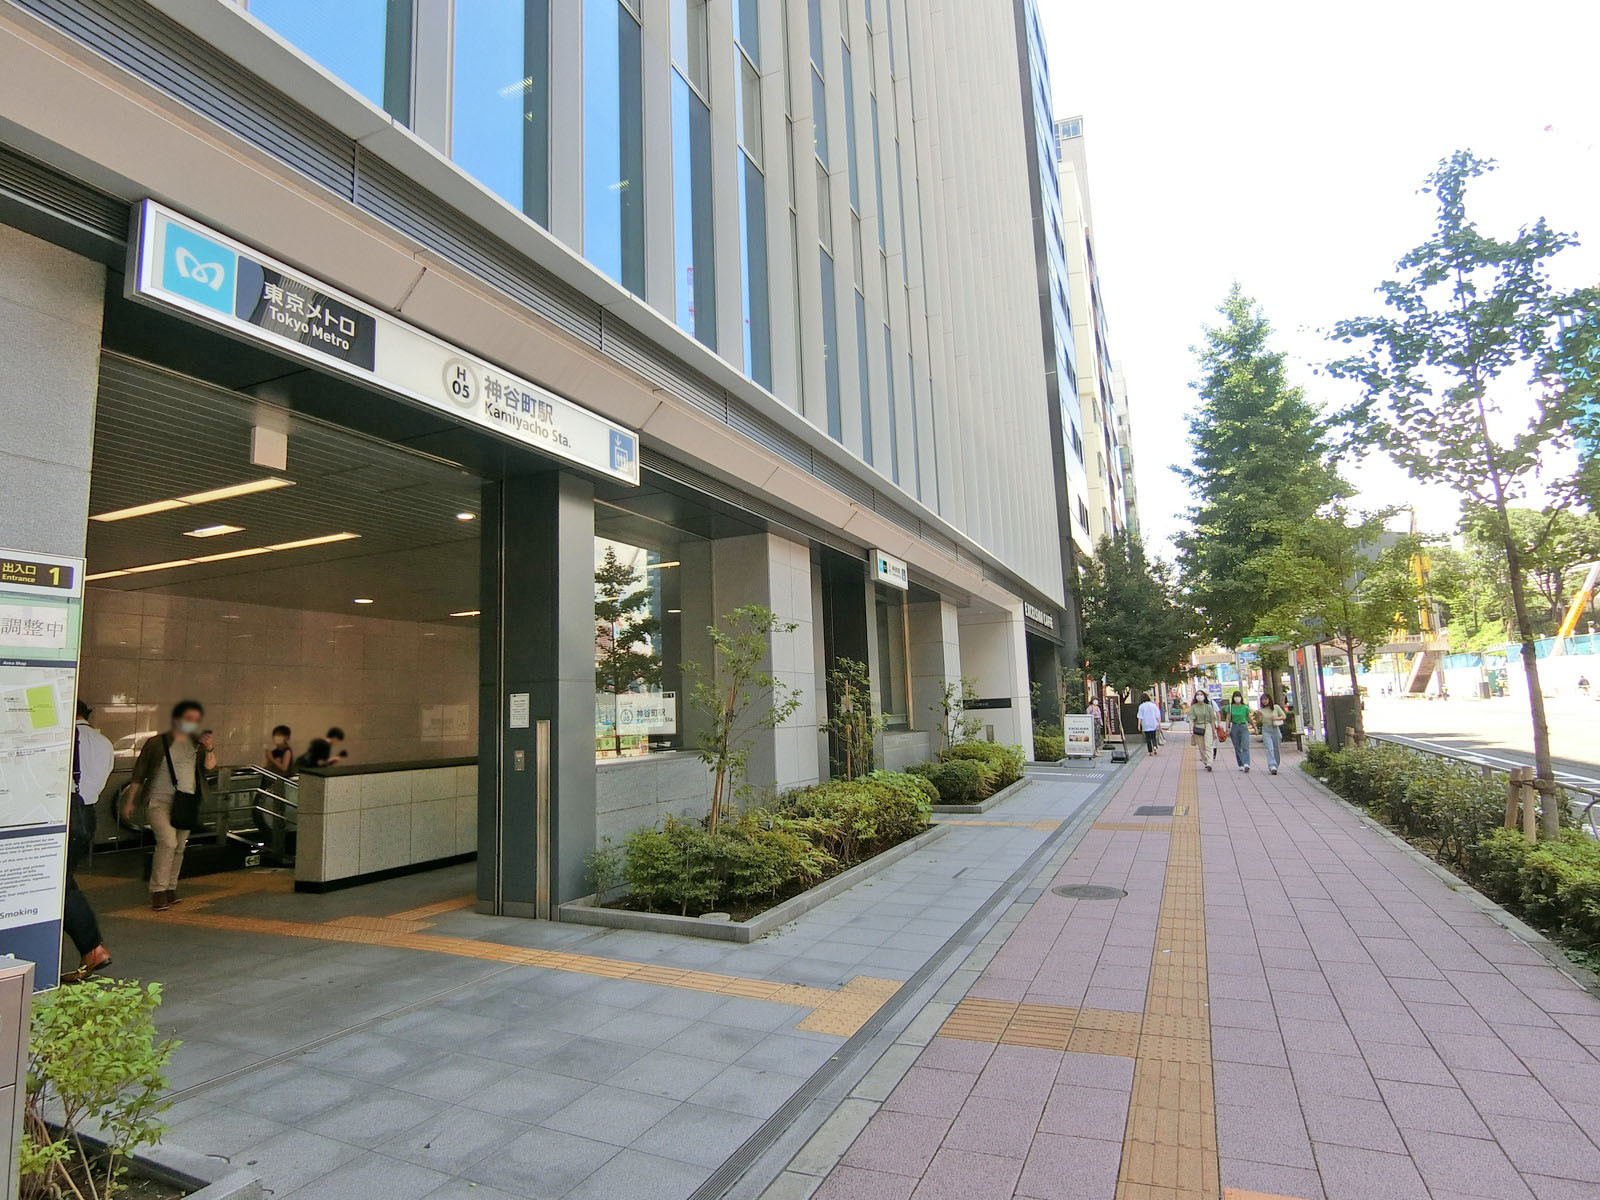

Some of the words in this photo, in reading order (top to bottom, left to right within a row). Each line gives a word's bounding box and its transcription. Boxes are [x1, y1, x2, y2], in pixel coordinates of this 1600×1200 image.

[264, 282, 355, 337] 東京メトロ
[269, 305, 309, 333] Tokyo
[312, 324, 350, 350] Metro
[456, 366, 466, 382] H
[452, 380, 470, 399] 05
[484, 375, 553, 426] 神谷町駅
[484, 400, 549, 439] Kamiyacho
[552, 428, 572, 448] Sta.
[2, 563, 37, 575] 出入口
[2, 574, 36, 583] Entrance
[49, 567, 60, 586] 1
[1, 617, 63, 638] 調整中
[0, 906, 38, 919] Smoking
